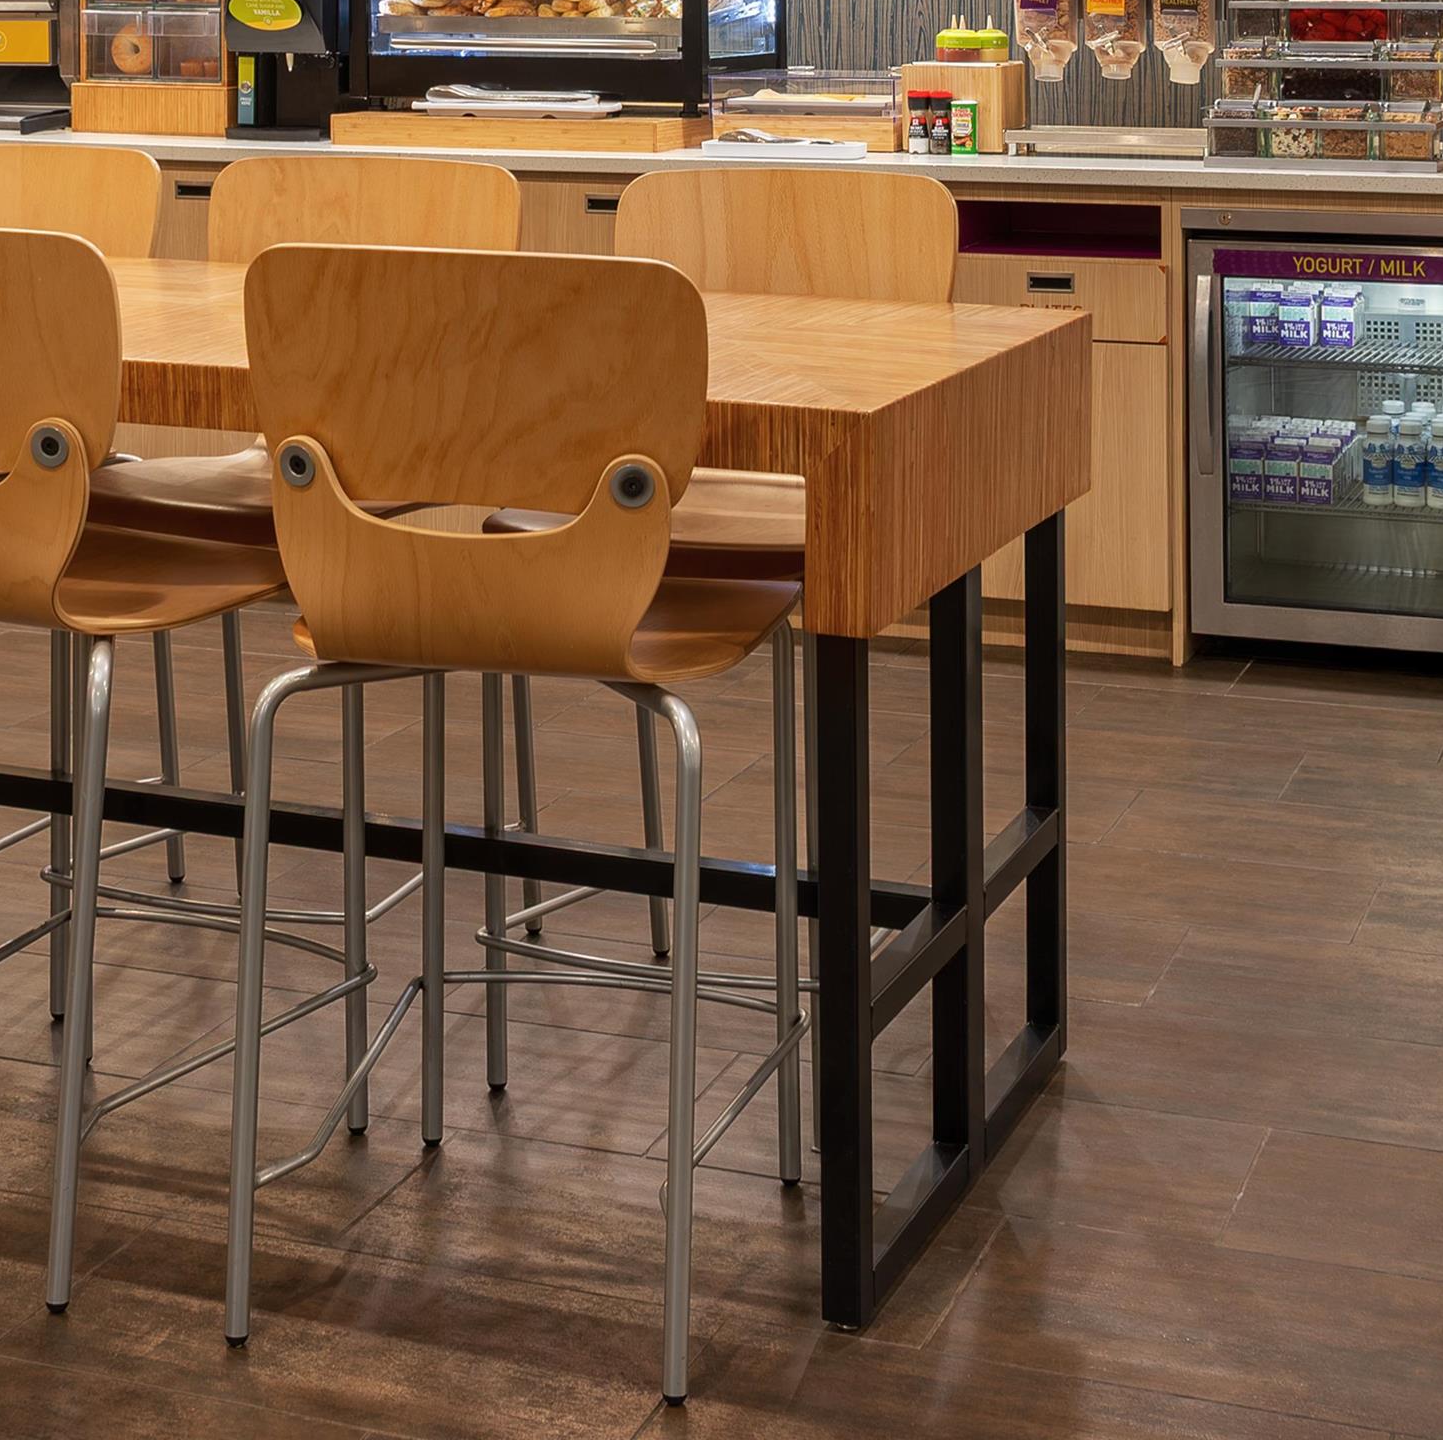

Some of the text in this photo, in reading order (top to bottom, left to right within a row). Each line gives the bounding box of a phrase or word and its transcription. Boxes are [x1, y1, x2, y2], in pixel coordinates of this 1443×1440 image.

[253, 9, 281, 17] VANILLA
[1293, 256, 1363, 274] YOGURT
[1380, 259, 1426, 277] MILK
[1252, 325, 1279, 334] MILK
[1280, 329, 1308, 339] MILK
[1322, 330, 1351, 339] MILK
[1232, 483, 1260, 492] MILK
[1266, 485, 1294, 494] MILK
[1301, 487, 1329, 497] MILK
